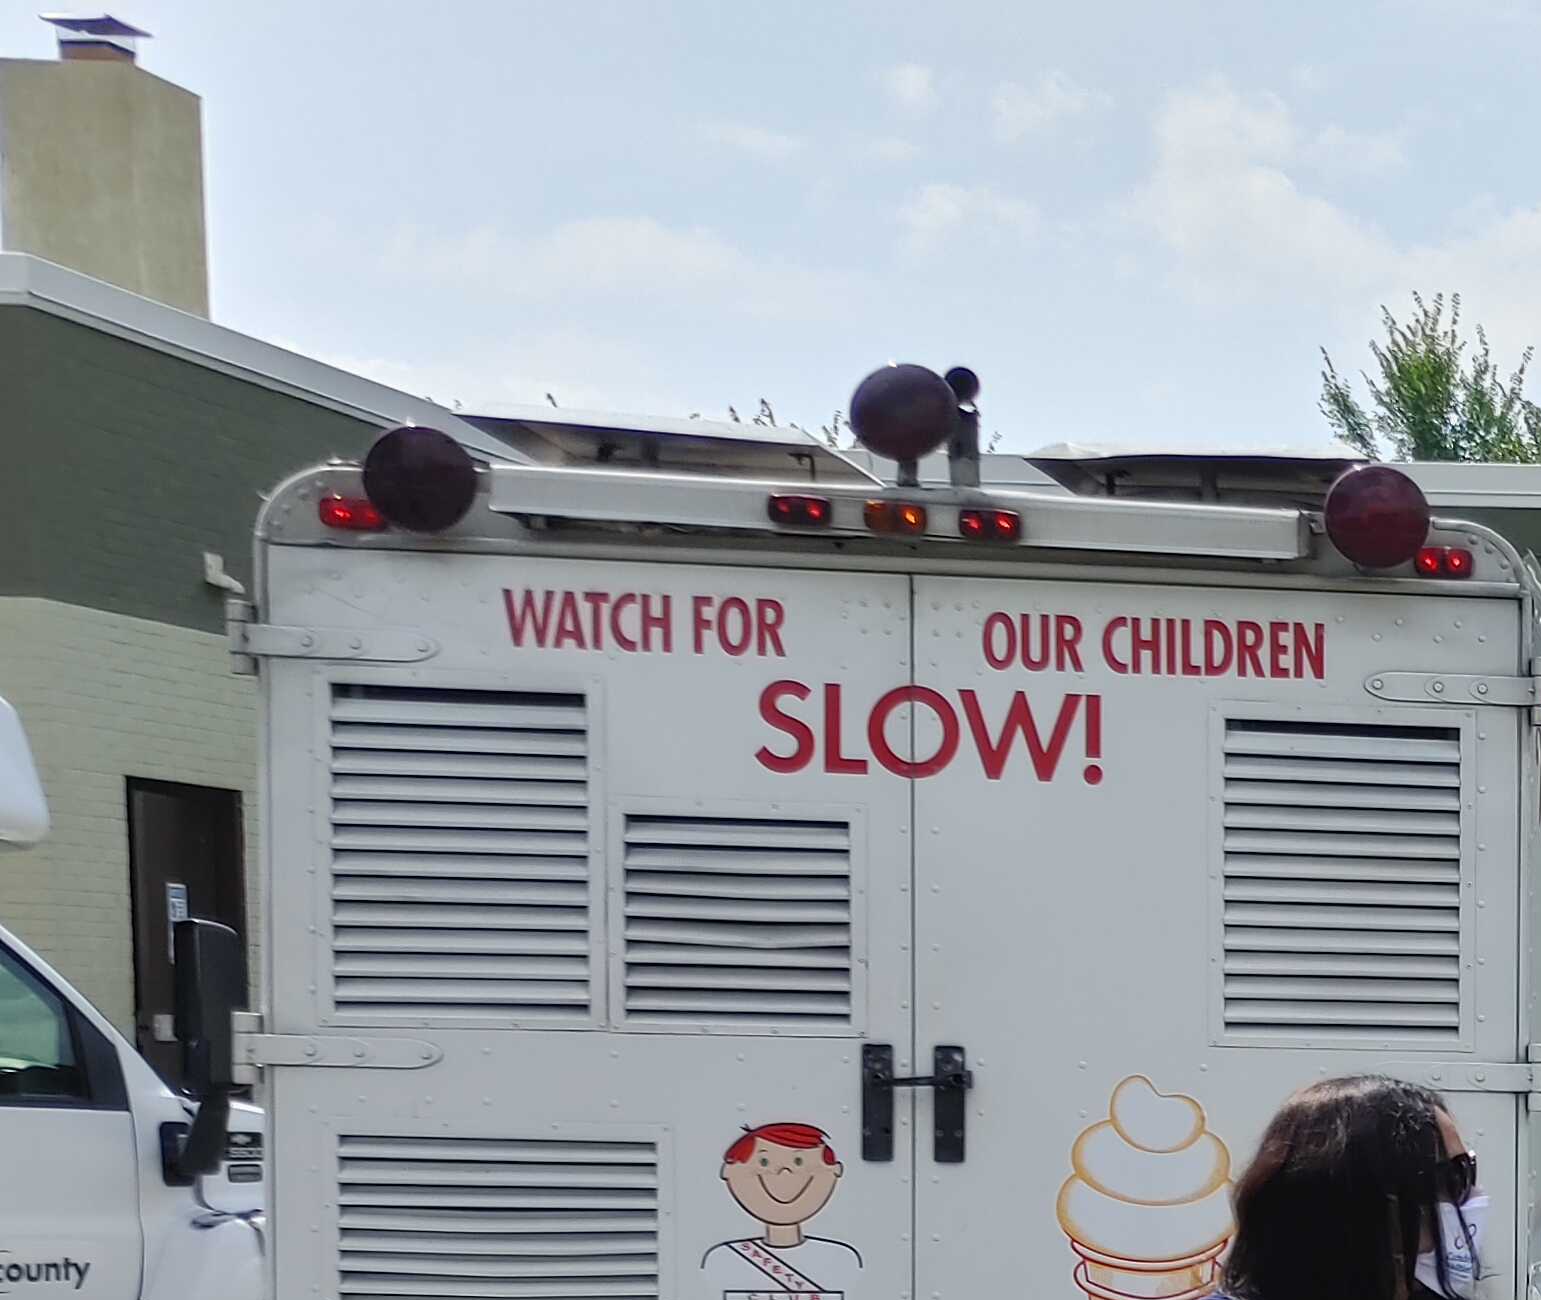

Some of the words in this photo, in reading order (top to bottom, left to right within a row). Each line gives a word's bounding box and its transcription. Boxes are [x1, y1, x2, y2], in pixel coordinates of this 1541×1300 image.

[503, 588, 673, 653] WATCH
[693, 596, 786, 658] FOR
[982, 611, 1084, 673] OUR
[1101, 615, 1326, 681] CHILDREN
[755, 680, 1103, 786] SLOW!
[0, 1256, 91, 1290] ounty
[741, 1242, 804, 1290] SAFETY
